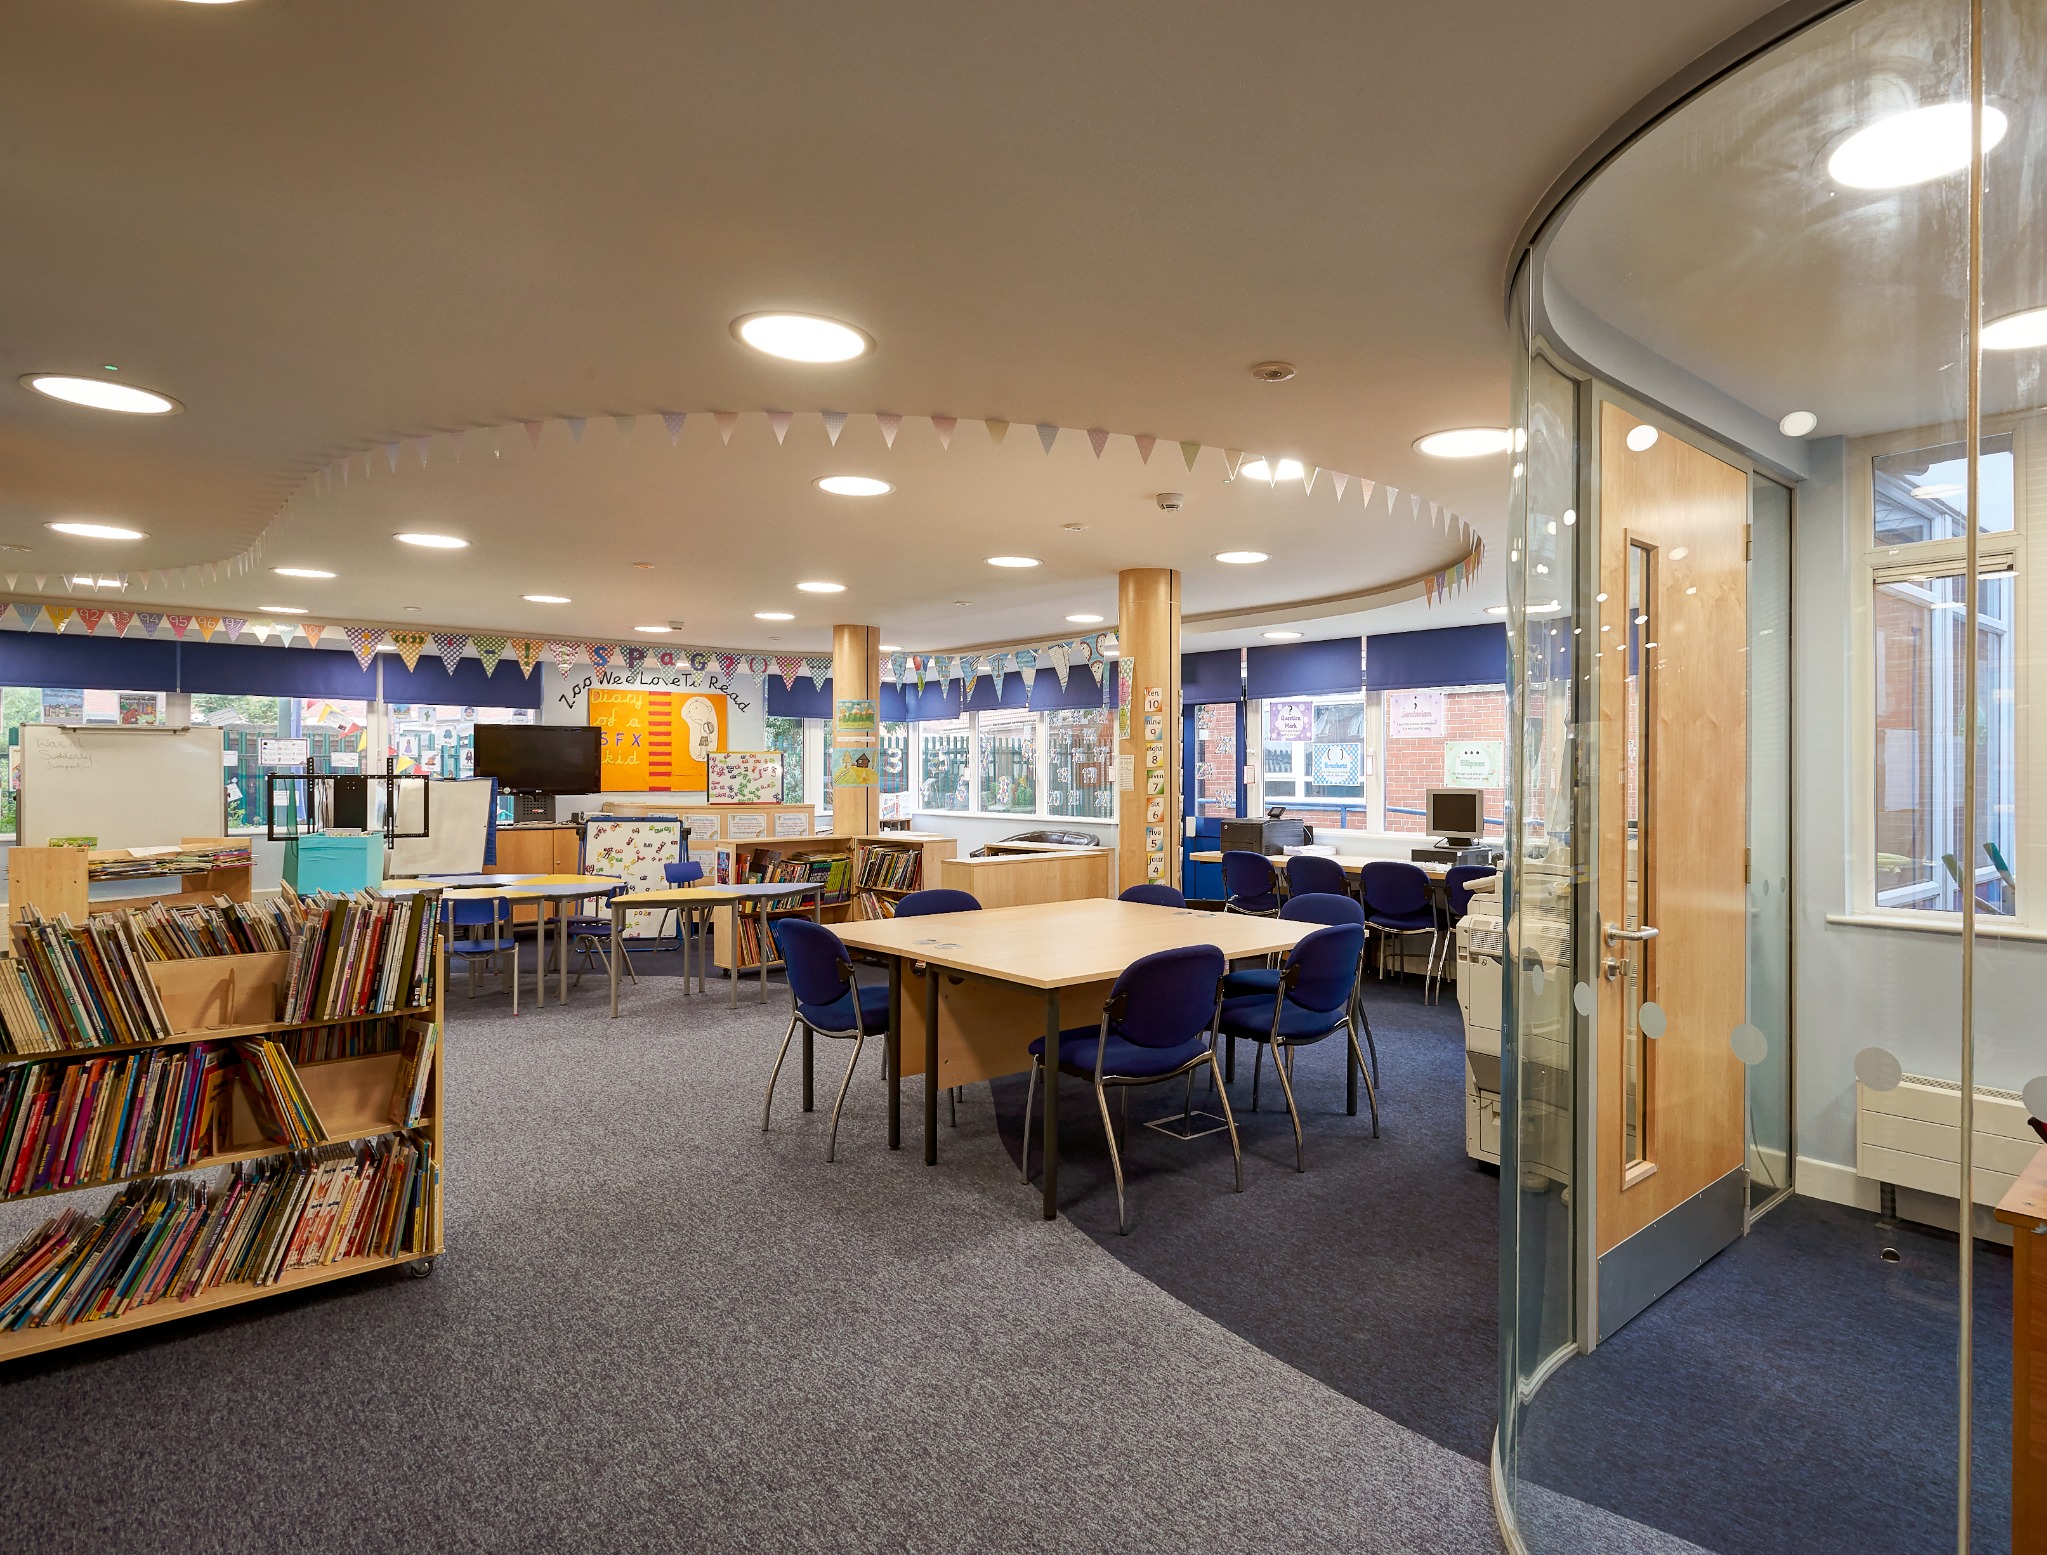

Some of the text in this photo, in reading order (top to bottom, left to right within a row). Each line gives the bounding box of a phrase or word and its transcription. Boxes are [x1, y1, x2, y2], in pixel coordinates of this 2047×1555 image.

[79, 609, 100, 621] 92
[114, 611, 130, 623] 93
[140, 613, 160, 624] 94
[169, 615, 188, 627] 95
[198, 617, 216, 629] 96
[226, 618, 243, 629] 97
[304, 625, 323, 635] 100
[558, 676, 593, 709] Zoo
[708, 675, 751, 713] Read
[591, 689, 643, 710] Diary
[1147, 700, 1160, 709] 10
[593, 707, 642, 728] of a
[1150, 728, 1157, 738] 9
[1146, 744, 1163, 754] eight
[601, 749, 640, 765] kid
[1151, 755, 1158, 765] 8
[1152, 782, 1159, 792] 7
[1152, 810, 1159, 820] 6
[1148, 828, 1162, 838] five
[1151, 839, 1158, 849] 5
[1148, 855, 1164, 866] four
[1152, 866, 1160, 875] 4
